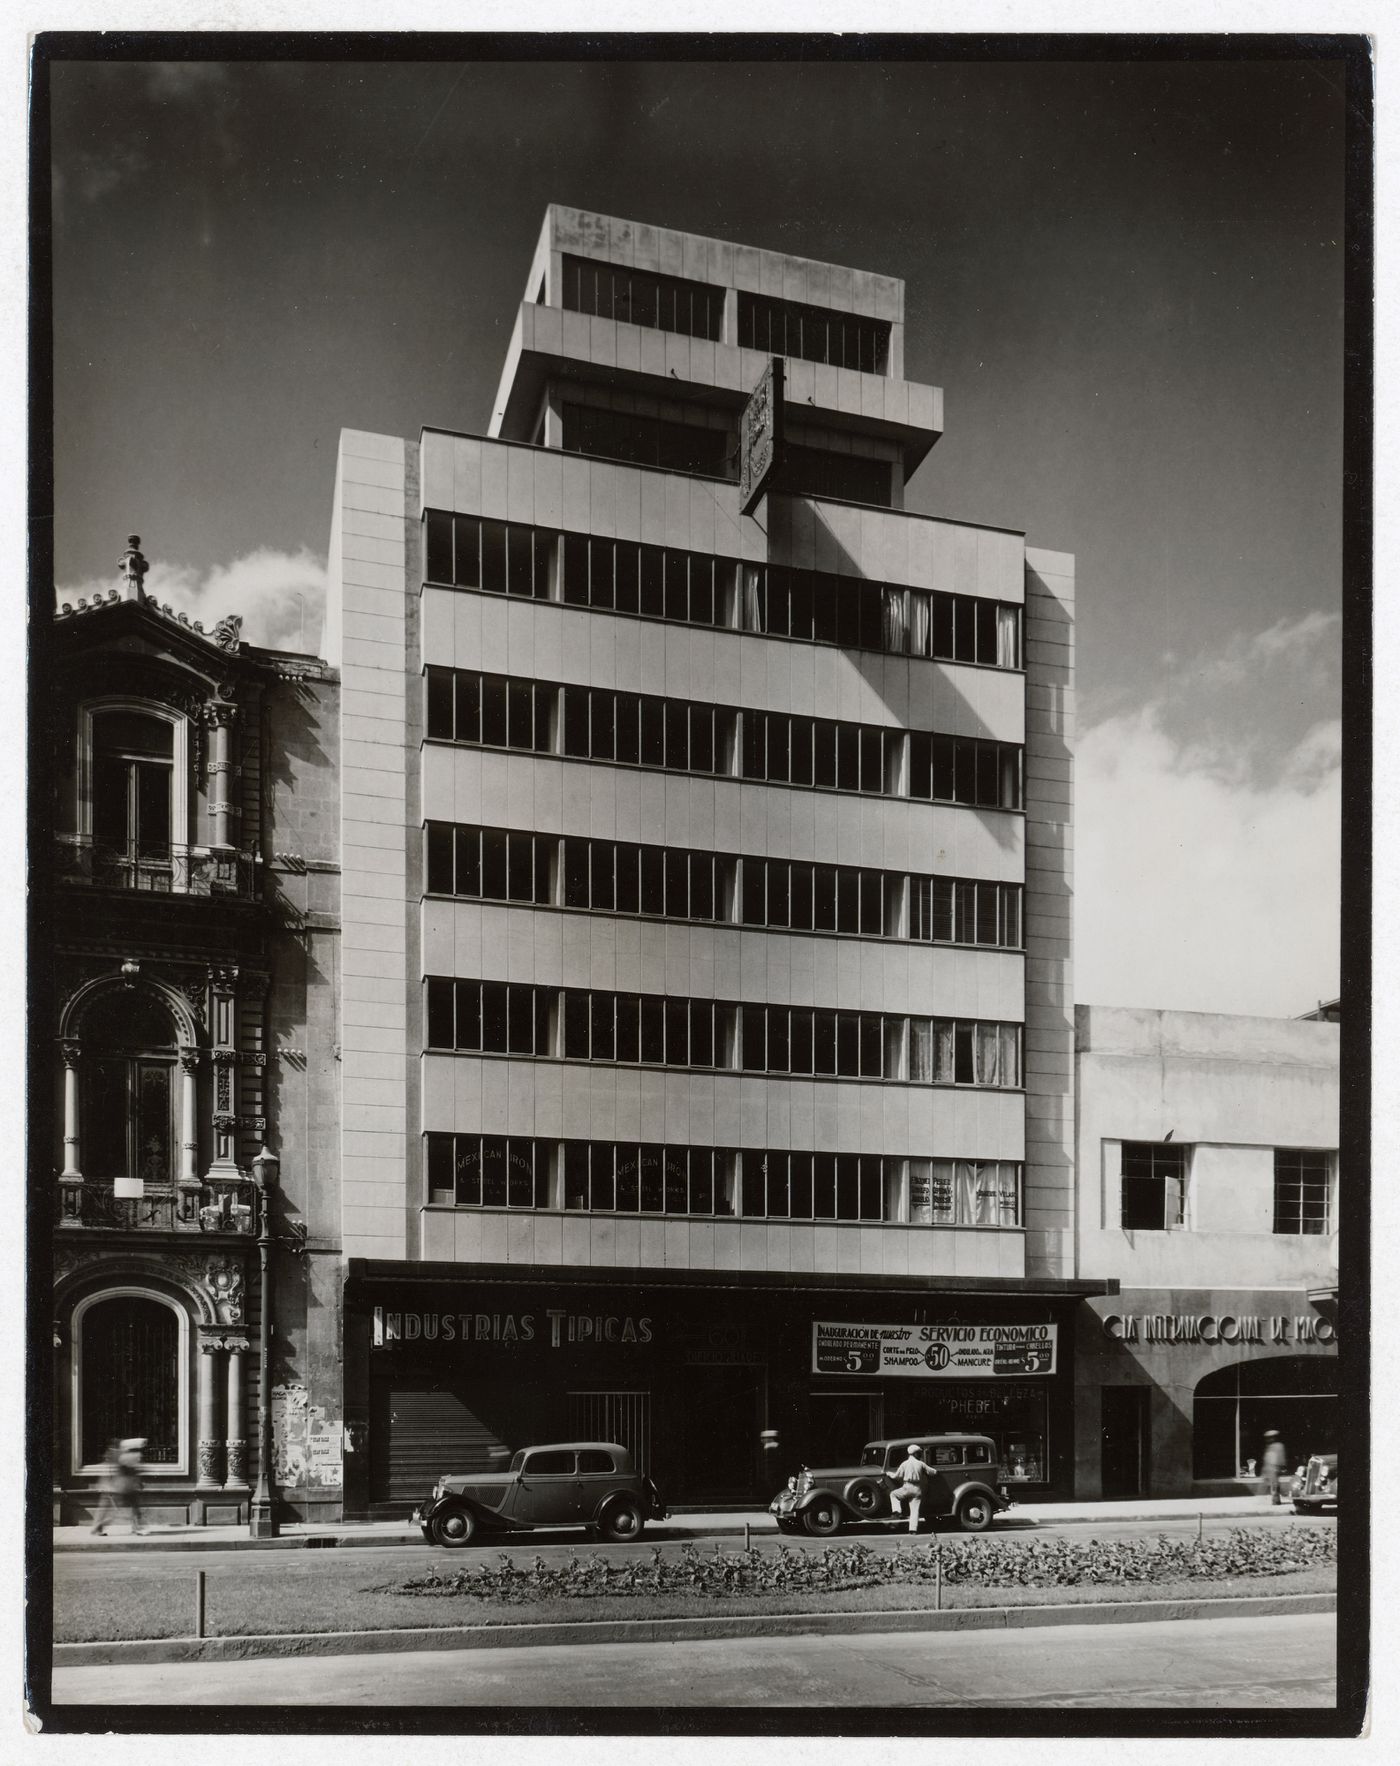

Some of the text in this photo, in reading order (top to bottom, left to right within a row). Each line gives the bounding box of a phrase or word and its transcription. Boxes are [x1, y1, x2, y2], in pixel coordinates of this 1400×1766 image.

[618, 1158, 658, 1177] MEXCAN
[373, 1306, 653, 1347] INDUSTRIAS TIPICAS
[919, 1327, 976, 1343] SERVICIO
[979, 1325, 1048, 1342] ECONOMICO
